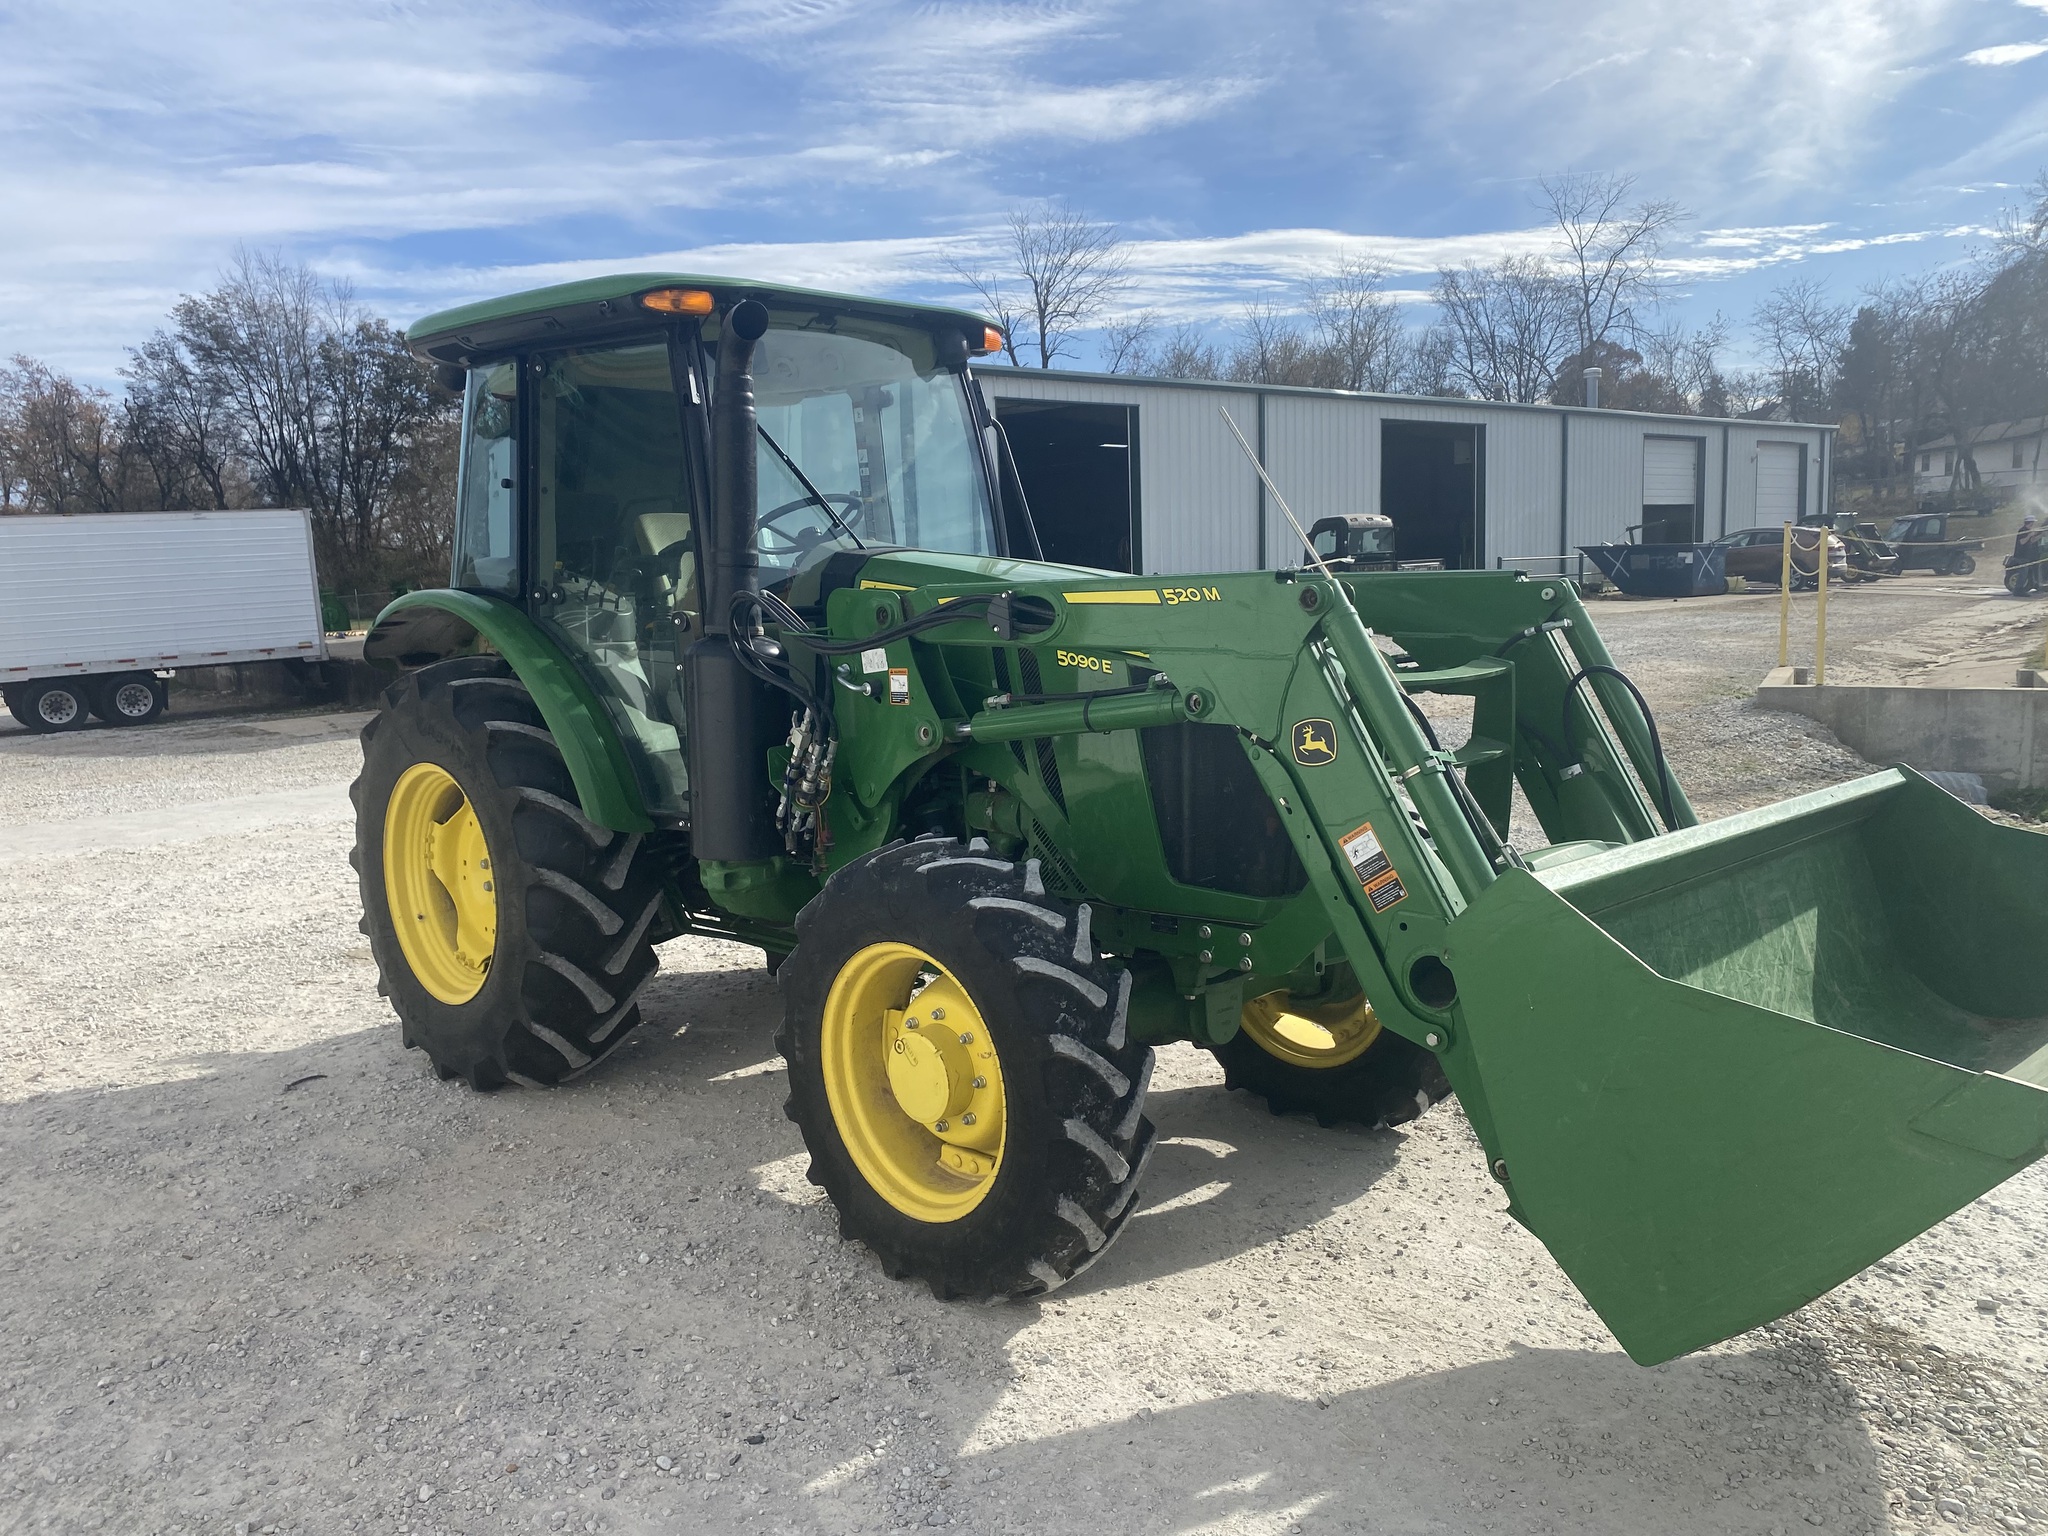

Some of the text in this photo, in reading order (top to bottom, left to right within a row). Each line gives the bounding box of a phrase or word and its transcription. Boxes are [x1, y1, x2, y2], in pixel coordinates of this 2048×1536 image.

[1161, 586, 1222, 605] 520 M
[1056, 649, 1113, 674] 5090 E
[1348, 825, 1368, 839] WARNING
[1373, 873, 1394, 888] WARNING
